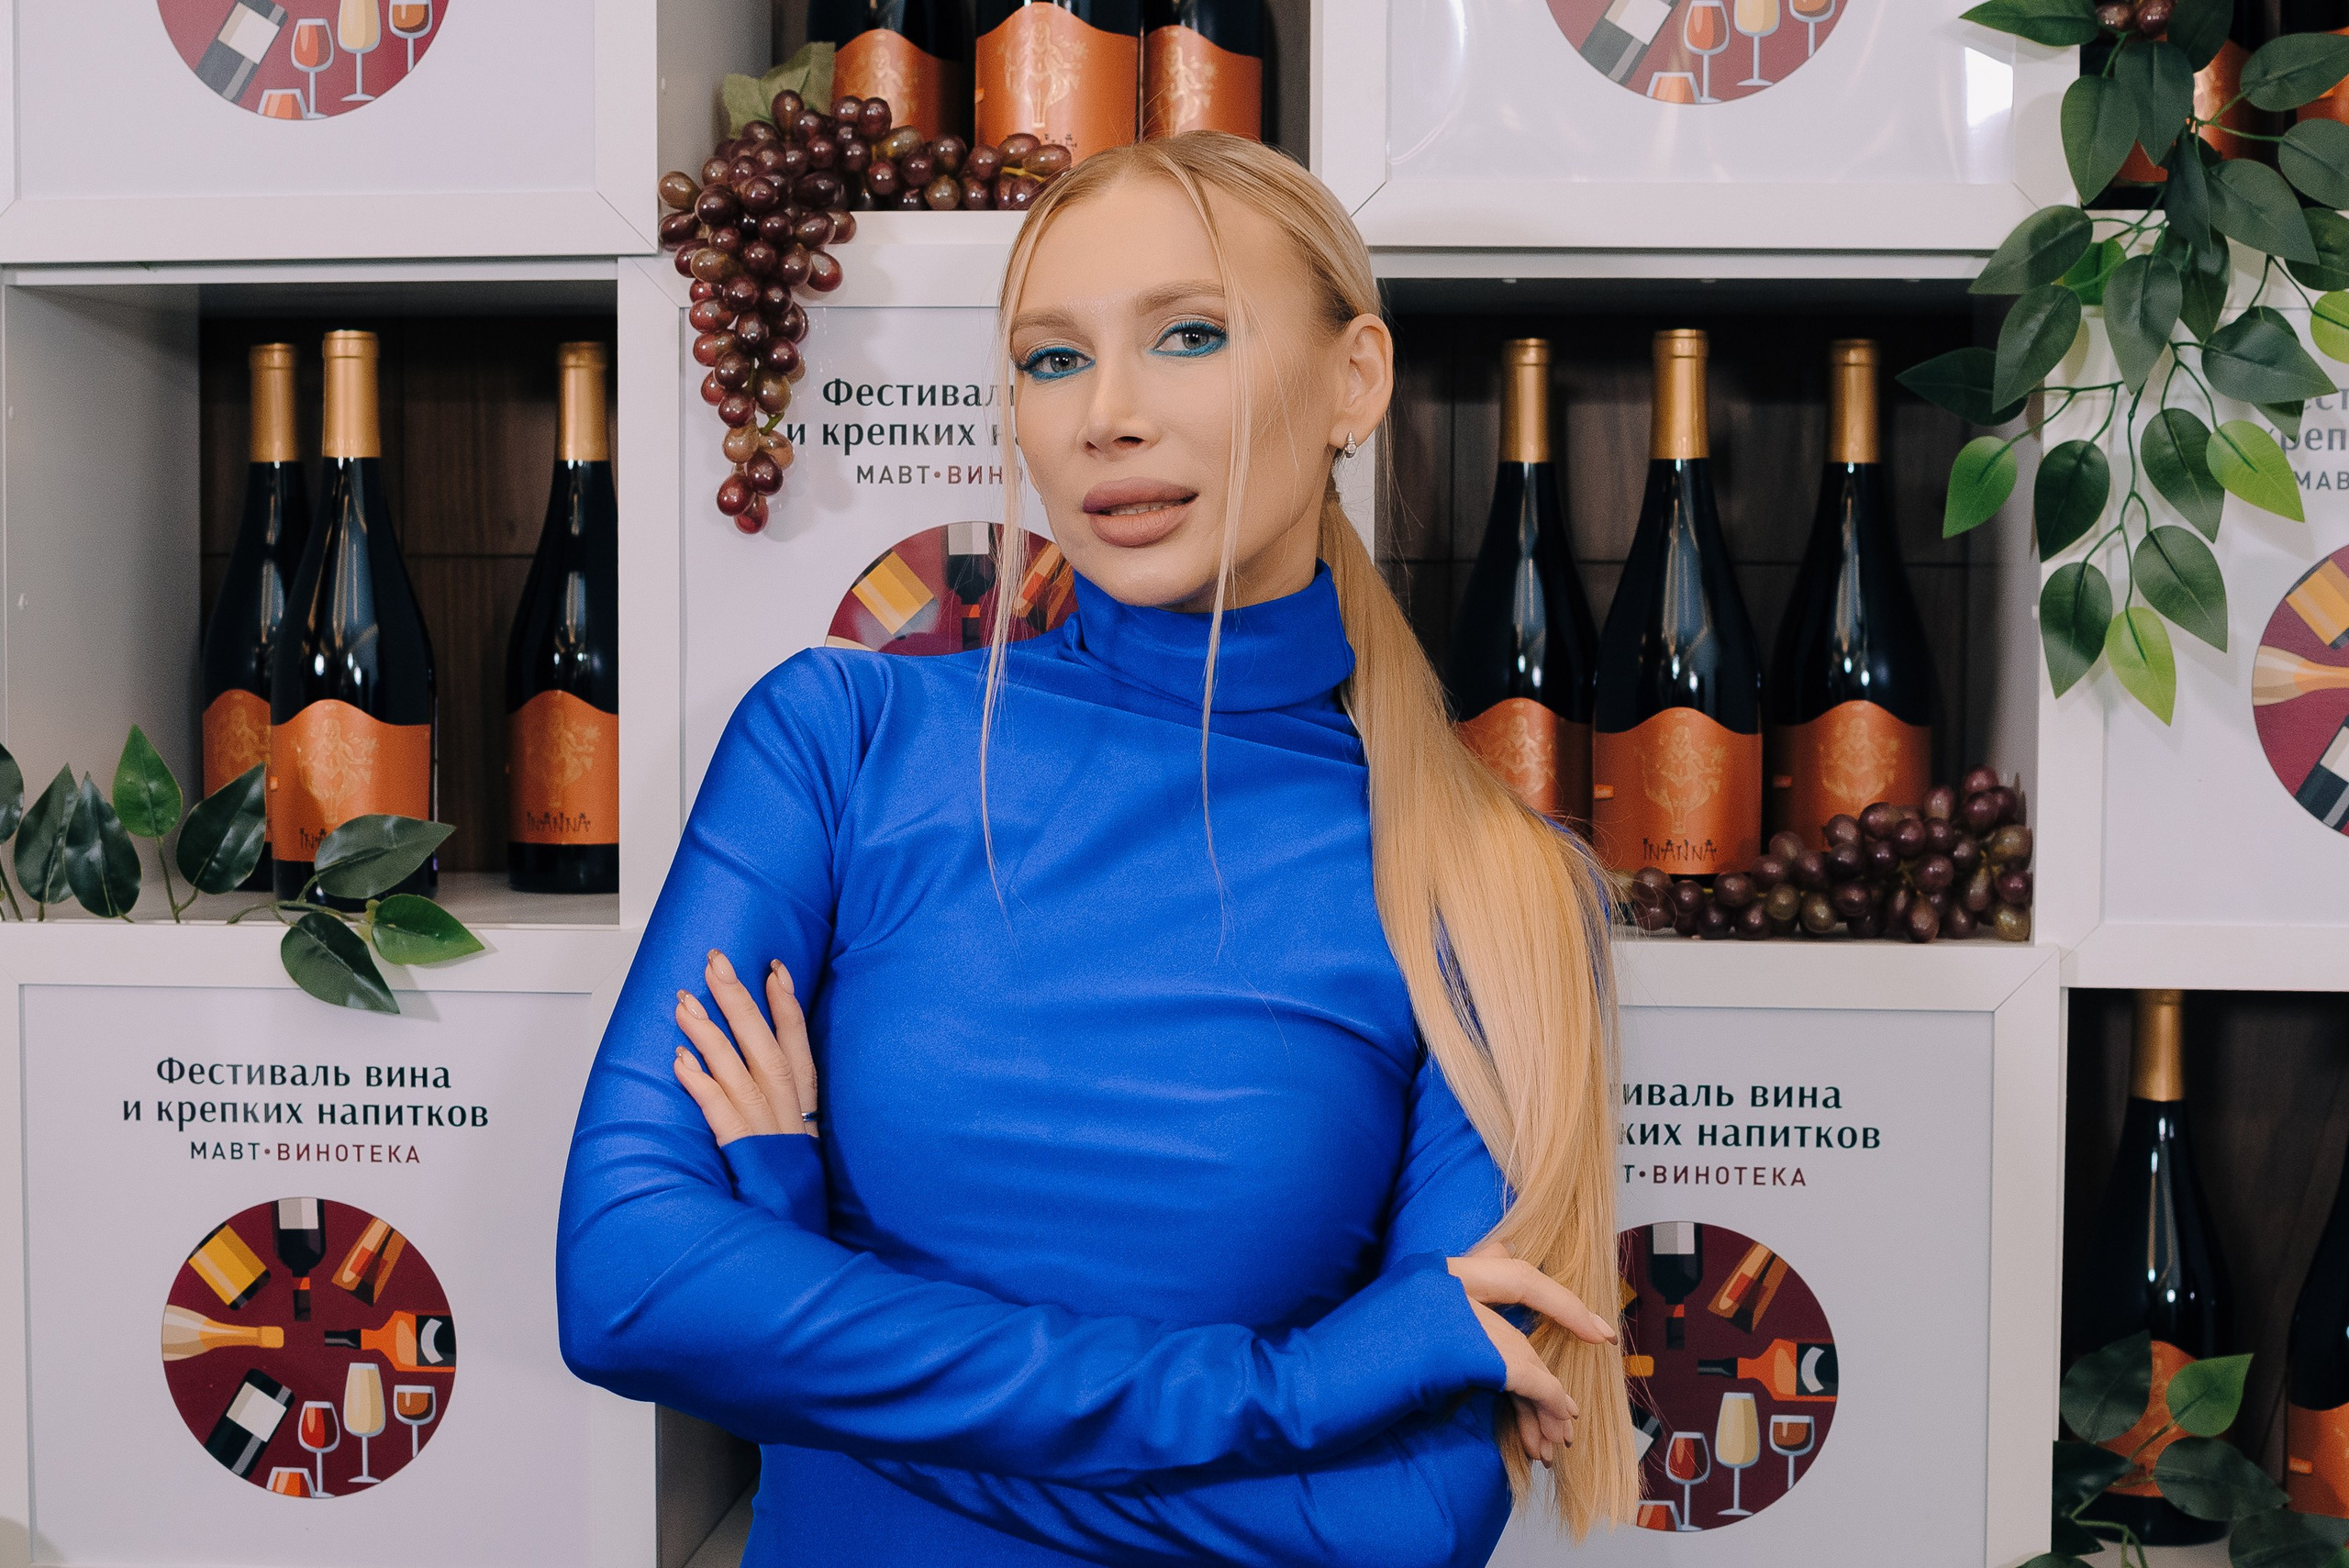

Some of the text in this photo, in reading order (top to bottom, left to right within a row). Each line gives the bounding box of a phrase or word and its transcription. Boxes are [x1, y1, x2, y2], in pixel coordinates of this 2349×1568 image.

[786, 423, 806, 446] и
[822, 423, 976, 456] крепких
[1642, 838, 1717, 862] INANNA
[156, 1056, 452, 1089] Фестиваль вина
[1621, 1083, 1843, 1109] иваль вина
[122, 1100, 489, 1132] и крепких напитков
[1698, 1124, 1881, 1150] напитков
